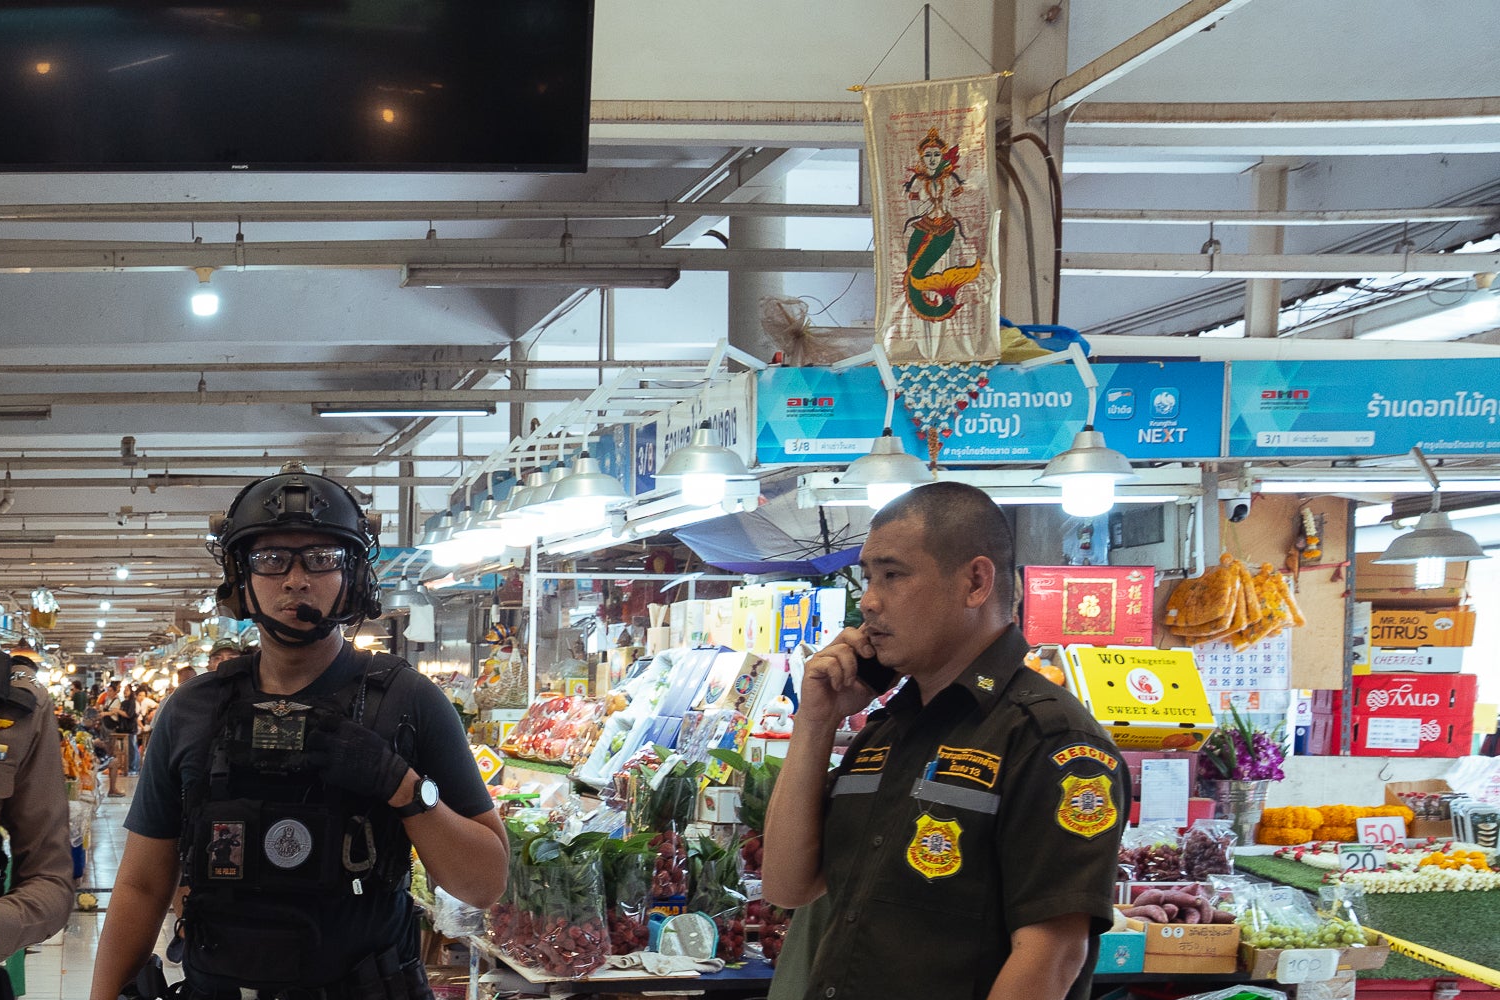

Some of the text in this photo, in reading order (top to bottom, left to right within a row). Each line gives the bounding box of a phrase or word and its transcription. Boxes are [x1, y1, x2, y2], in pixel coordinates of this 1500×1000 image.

[954, 413, 1021, 439] (ขวัญ)
[1137, 427, 1188, 444] NEXT
[1265, 434, 1281, 444] 3/1
[792, 441, 810, 452] 3/8
[638, 442, 654, 476] 3/8
[1077, 594, 1102, 618] 福
[1399, 616, 1420, 624] RAO
[1371, 625, 1429, 640] CITRUS
[1098, 653, 1177, 667] WO Tangerine
[1210, 654, 1219, 662] 14
[1222, 654, 1232, 662] 15
[1236, 654, 1245, 662] 16
[1249, 654, 1258, 662] 17
[1263, 654, 1272, 662] 18
[1373, 656, 1424, 665] CHERRIES
[1209, 667, 1217, 675] 21
[1222, 667, 1231, 675] 22
[1235, 667, 1245, 675] 23
[1249, 667, 1258, 675] 24
[1263, 667, 1272, 675] 25
[1209, 678, 1258, 687] 28 29 30 31
[1389, 683, 1440, 706] envy
[1107, 705, 1197, 717] SWEET & JUICY
[1054, 745, 1118, 770] RESCUE
[1288, 958, 1322, 971] 100
